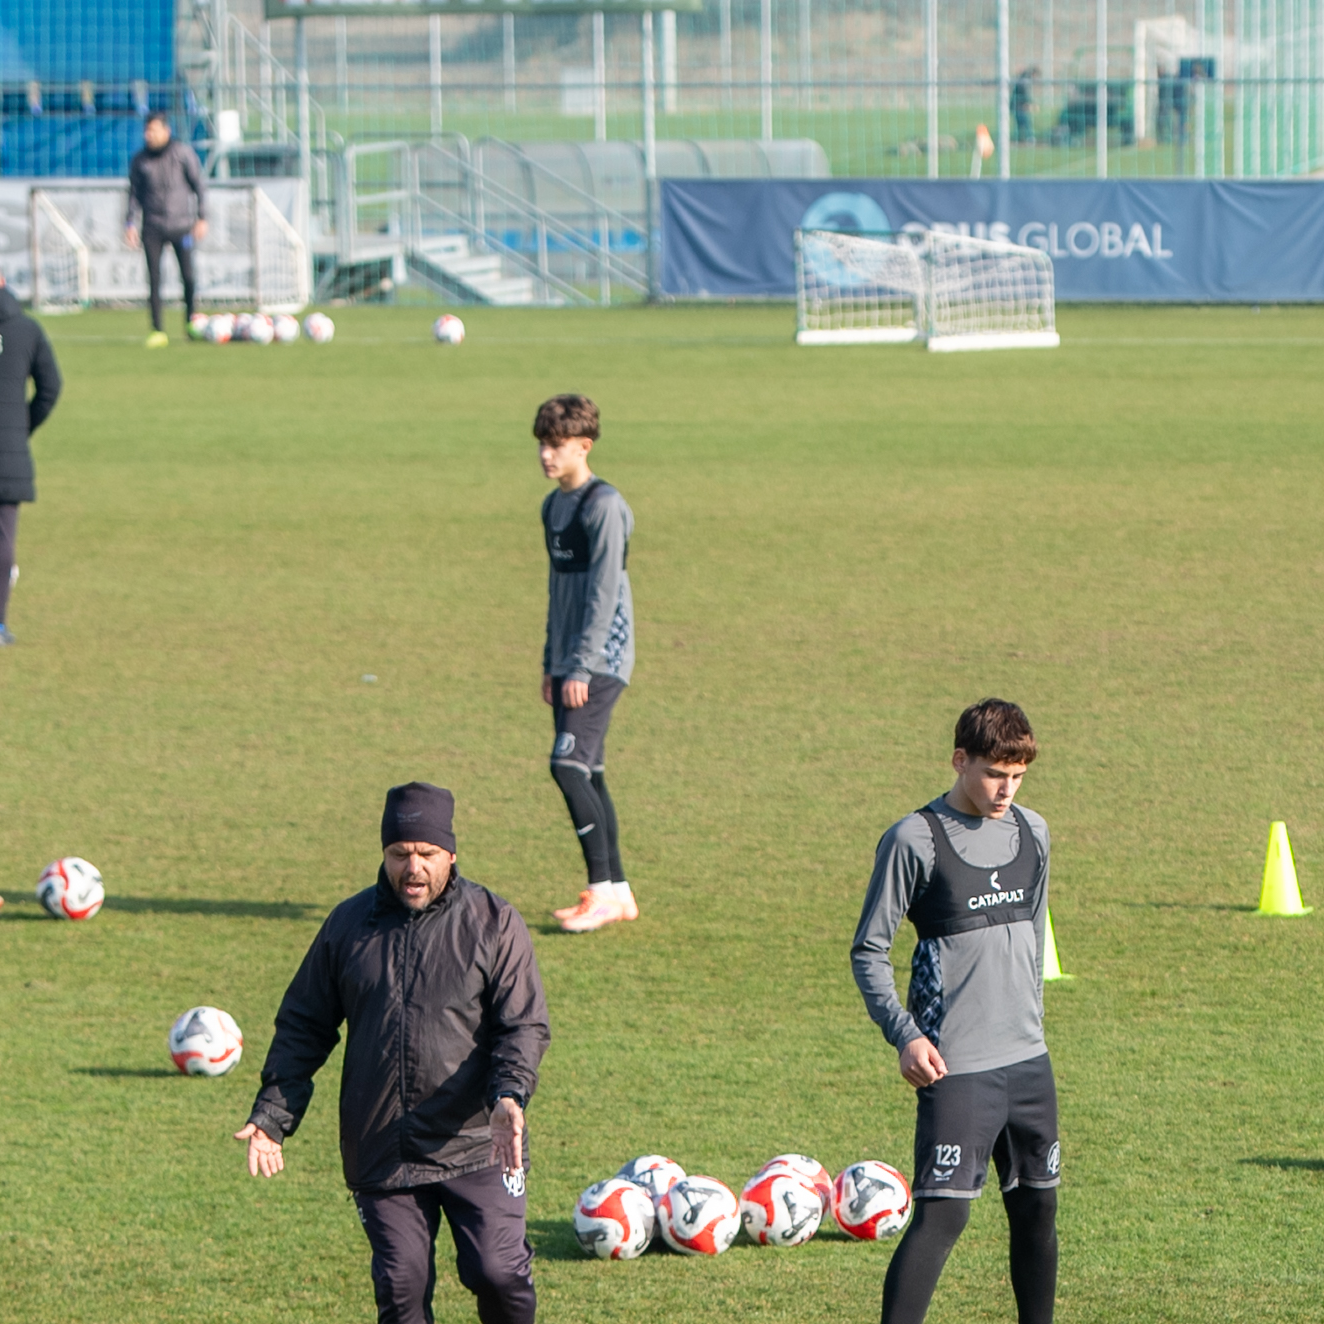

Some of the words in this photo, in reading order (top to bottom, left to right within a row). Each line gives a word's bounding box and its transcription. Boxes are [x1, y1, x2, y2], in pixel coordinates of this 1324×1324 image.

[1017, 221, 1174, 259] GLOBAL
[968, 888, 1024, 910] CATAPULT
[935, 1143, 961, 1167] 123
